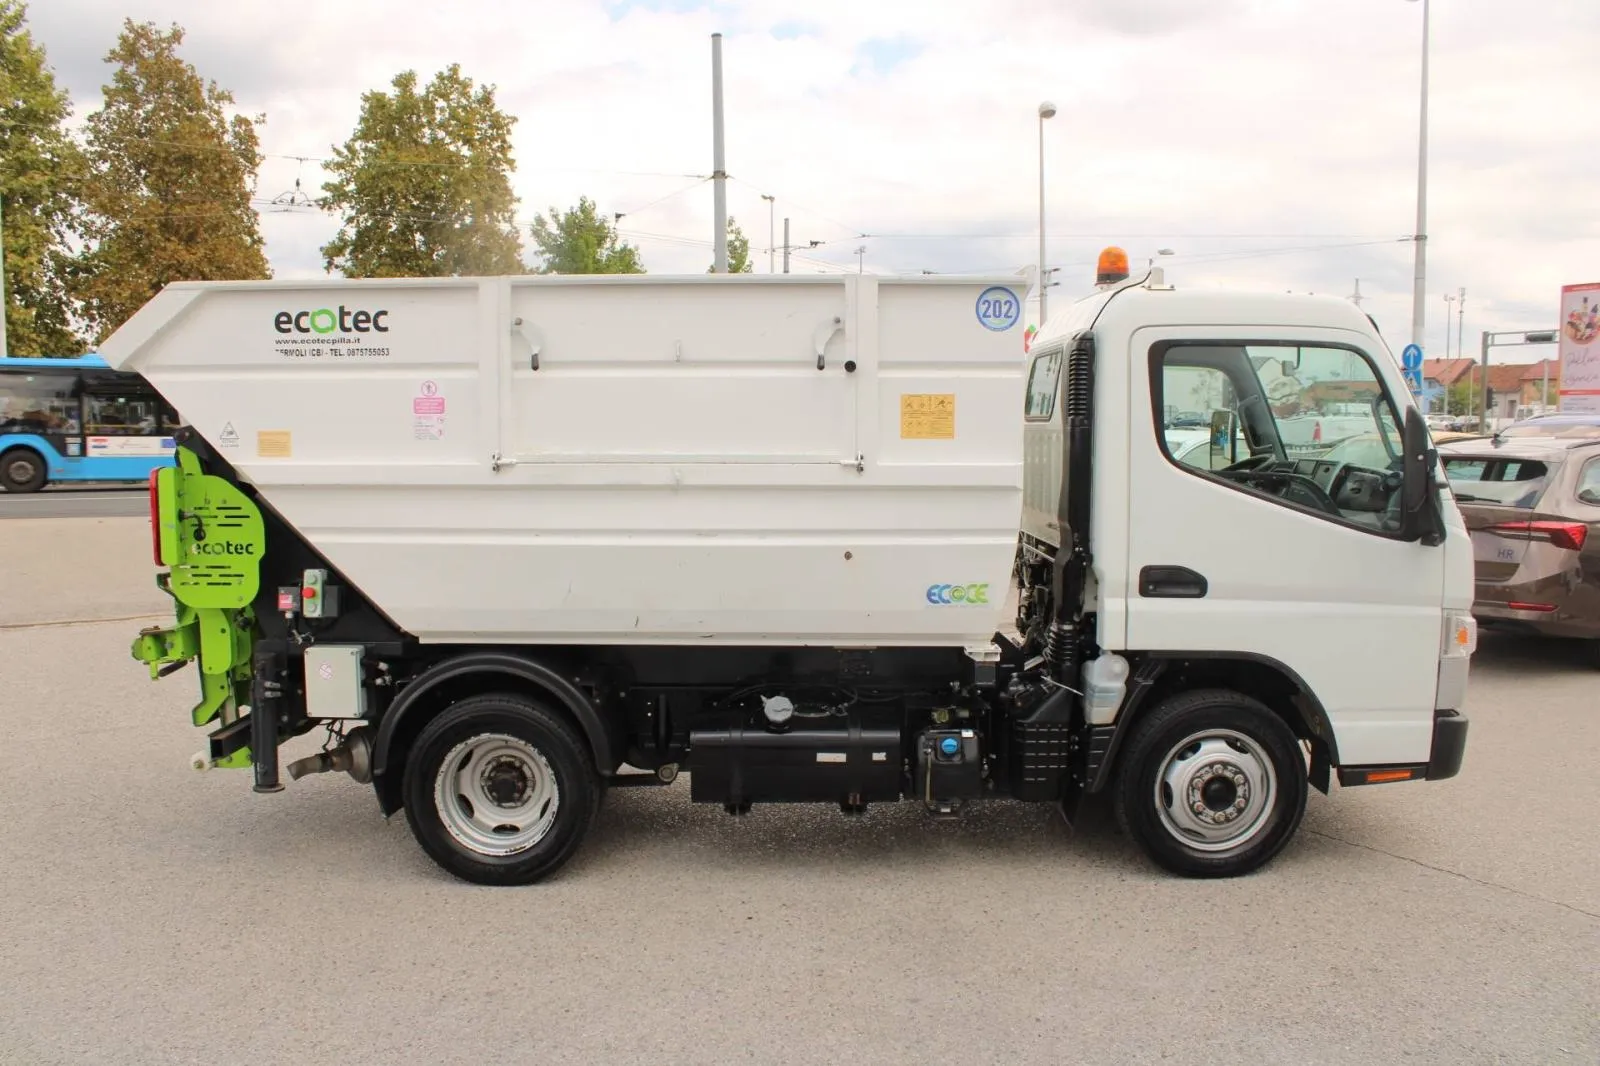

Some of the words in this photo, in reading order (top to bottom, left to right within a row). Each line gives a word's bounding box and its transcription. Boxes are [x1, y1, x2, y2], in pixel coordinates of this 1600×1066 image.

[982, 299, 1013, 318] 202
[274, 305, 389, 334] ecotec
[274, 337, 361, 346] www.ecotecpilla.it
[192, 541, 254, 555] ecotec
[1496, 548, 1514, 560] HR
